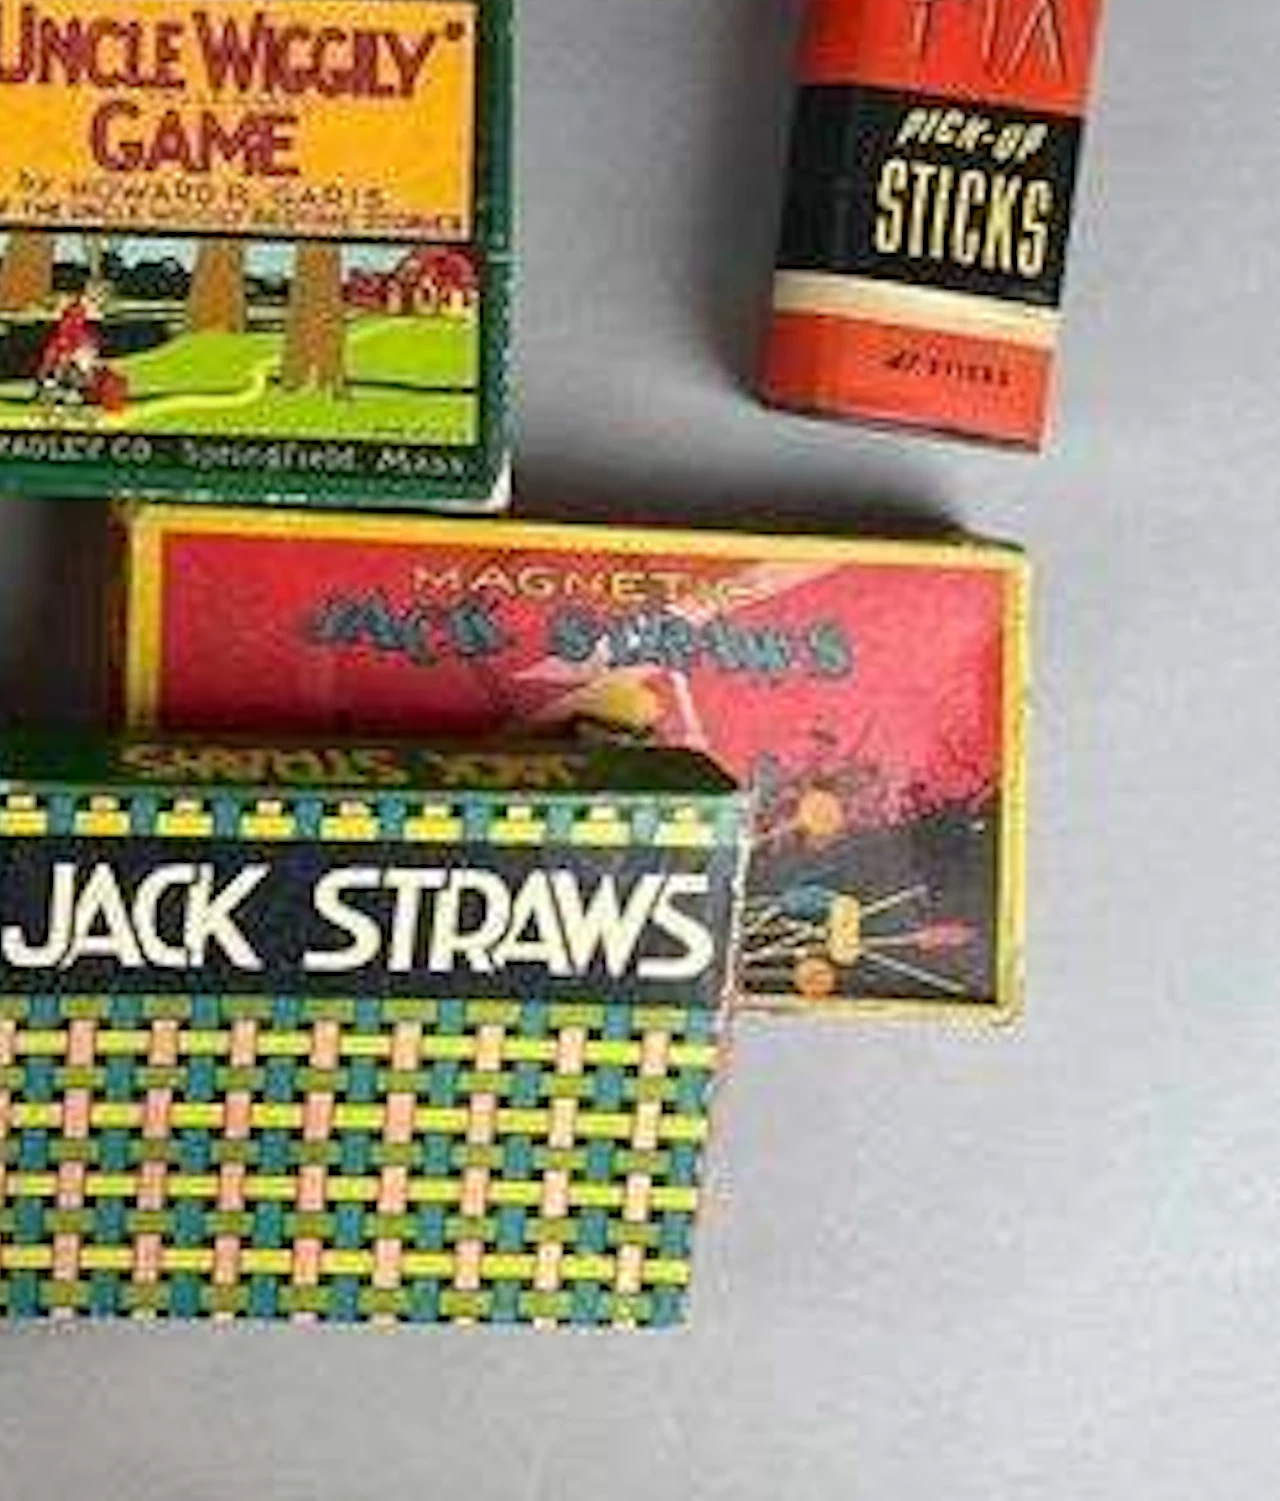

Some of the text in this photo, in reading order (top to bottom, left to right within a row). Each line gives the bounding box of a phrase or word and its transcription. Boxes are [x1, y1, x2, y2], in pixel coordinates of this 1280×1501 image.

[90, 100, 304, 178] GAME
[895, 105, 1051, 164] PICK-UP
[873, 155, 1057, 278] STICKS
[410, 564, 778, 608] MAGNETIC
[0, 860, 716, 980] JACK STRAWS
